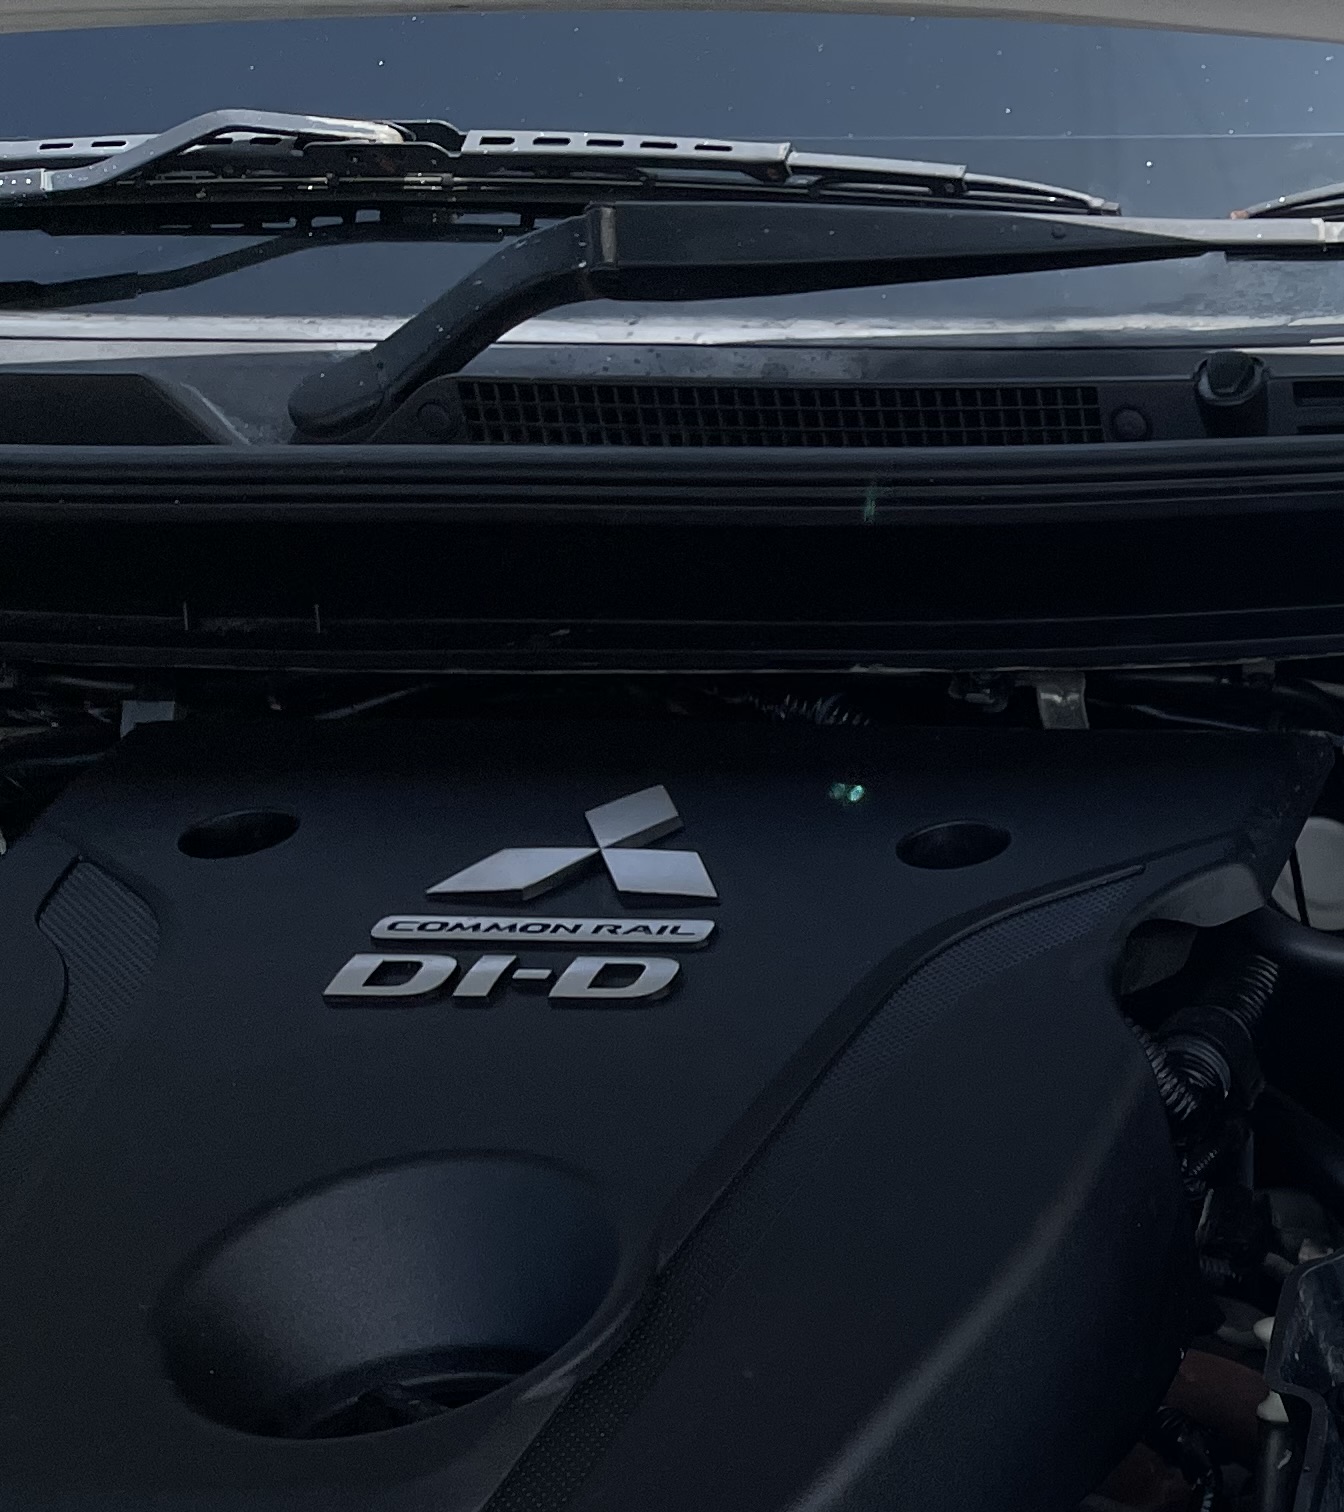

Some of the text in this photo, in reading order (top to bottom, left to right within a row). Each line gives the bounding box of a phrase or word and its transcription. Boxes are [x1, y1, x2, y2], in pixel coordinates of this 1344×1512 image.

[386, 919, 697, 938] COMMON RAIL
[323, 953, 682, 1001] DI-D
